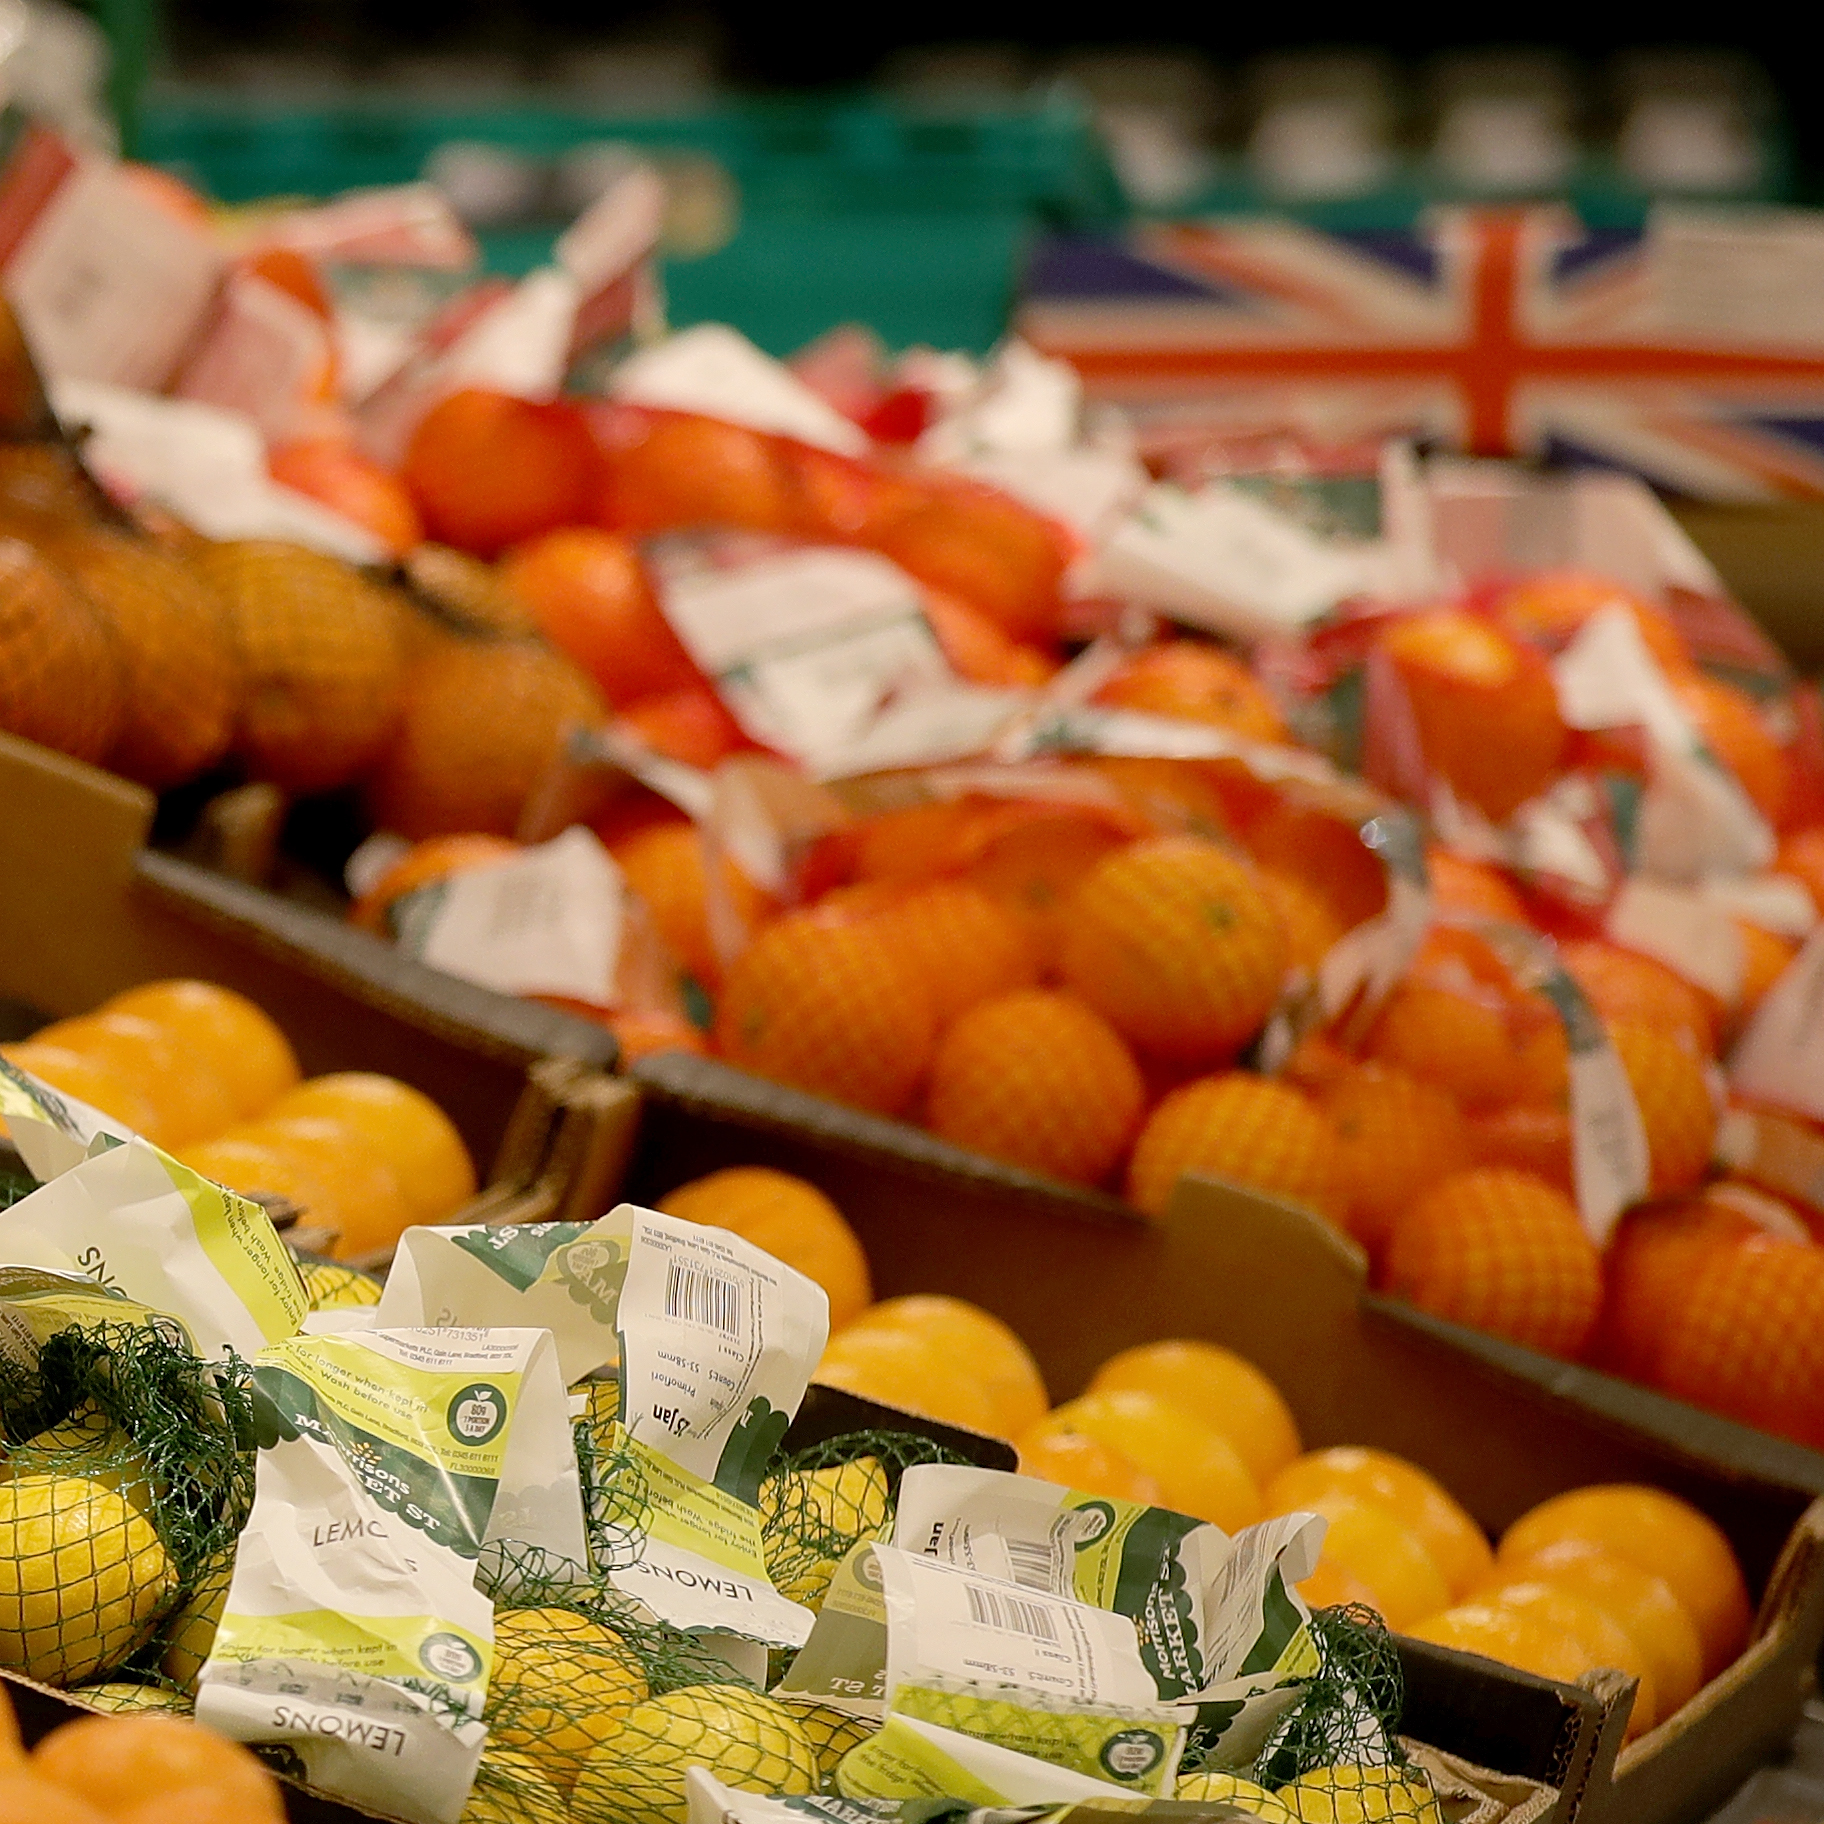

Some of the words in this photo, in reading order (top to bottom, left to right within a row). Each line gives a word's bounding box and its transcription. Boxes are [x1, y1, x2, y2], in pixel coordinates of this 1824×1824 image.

[228, 1215, 242, 1245] when
[487, 1225, 519, 1251] ST
[243, 1245, 269, 1280] longer
[250, 1233, 271, 1264] Wash
[269, 1279, 280, 1296] for
[280, 1297, 297, 1326] Enjoy
[446, 1328, 484, 1342] 731351
[657, 1351, 700, 1373] 53-58mm
[724, 1347, 744, 1363] Class
[314, 1353, 352, 1378] longer
[354, 1374, 386, 1393] when
[389, 1388, 419, 1411] kept
[322, 1370, 350, 1392] Wash
[354, 1387, 389, 1410] before
[394, 1407, 414, 1420] use
[651, 1372, 696, 1397] Primofiori
[470, 1404, 487, 1416] 80g
[652, 1403, 680, 1434] Jan
[406, 1503, 441, 1531] ST
[677, 1504, 703, 1522] Wash
[680, 1518, 711, 1539] longer
[924, 1521, 944, 1556] Jan
[635, 1560, 753, 1602] LEMONS
[1144, 1580, 1176, 1680] Morrisons
[1158, 1588, 1199, 1696] ARKET
[274, 1706, 406, 1756] LEMONS
